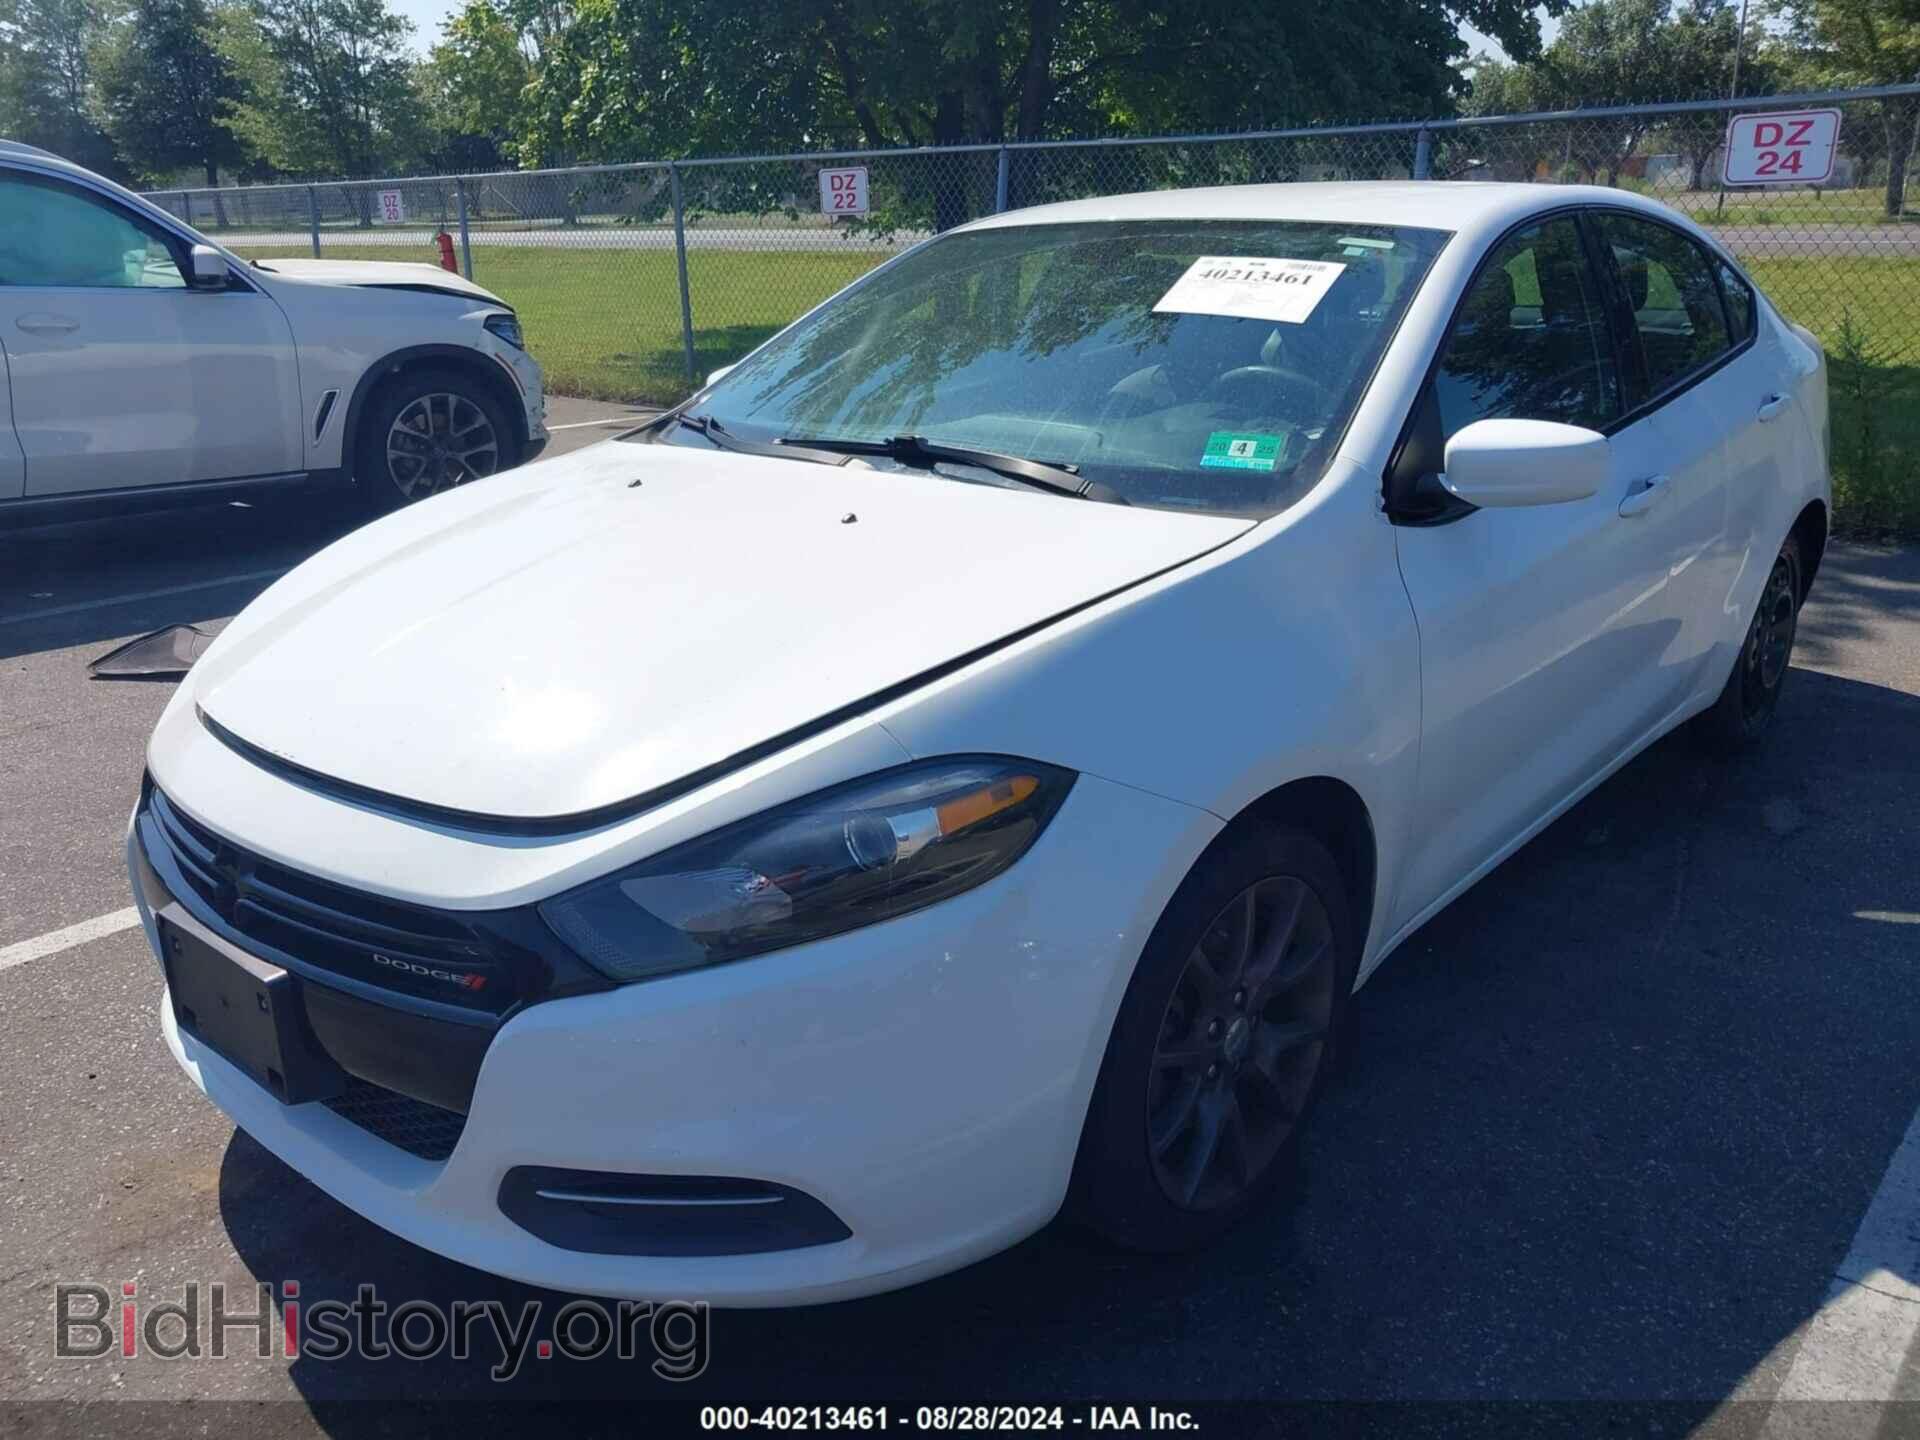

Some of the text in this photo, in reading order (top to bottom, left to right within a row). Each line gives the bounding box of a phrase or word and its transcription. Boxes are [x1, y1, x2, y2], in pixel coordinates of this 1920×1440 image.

[1753, 120, 1815, 148] DZ
[1755, 150, 1803, 175] 24
[830, 174, 857, 191] DZ
[383, 194, 398, 208] DZ
[833, 192, 857, 209] 22
[385, 207, 399, 221] 20
[1199, 268, 1313, 286] 40213461
[1236, 442, 1248, 455] 4
[373, 953, 470, 985] DODGE
